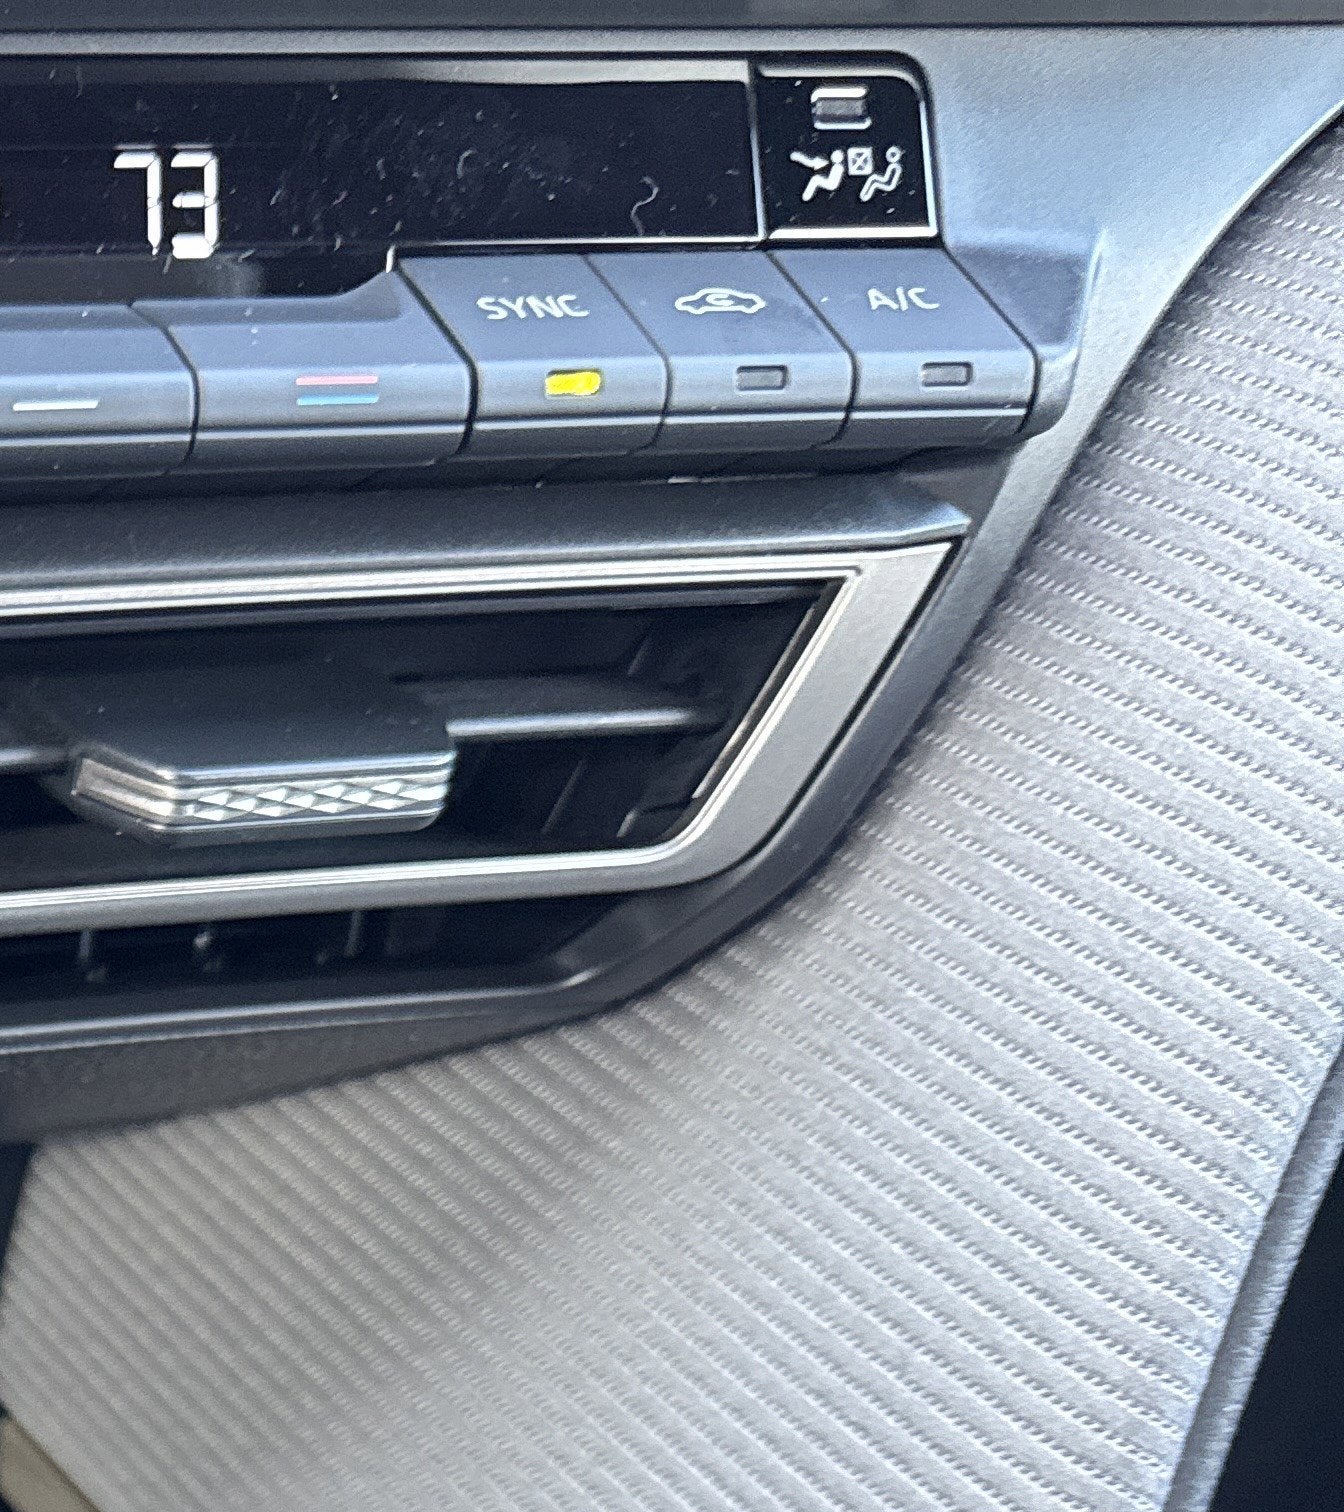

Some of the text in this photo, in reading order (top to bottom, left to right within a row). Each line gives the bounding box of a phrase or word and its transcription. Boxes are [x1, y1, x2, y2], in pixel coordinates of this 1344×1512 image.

[113, 150, 220, 260] 73
[476, 293, 590, 320] SYNC
[867, 286, 940, 312] A/C
